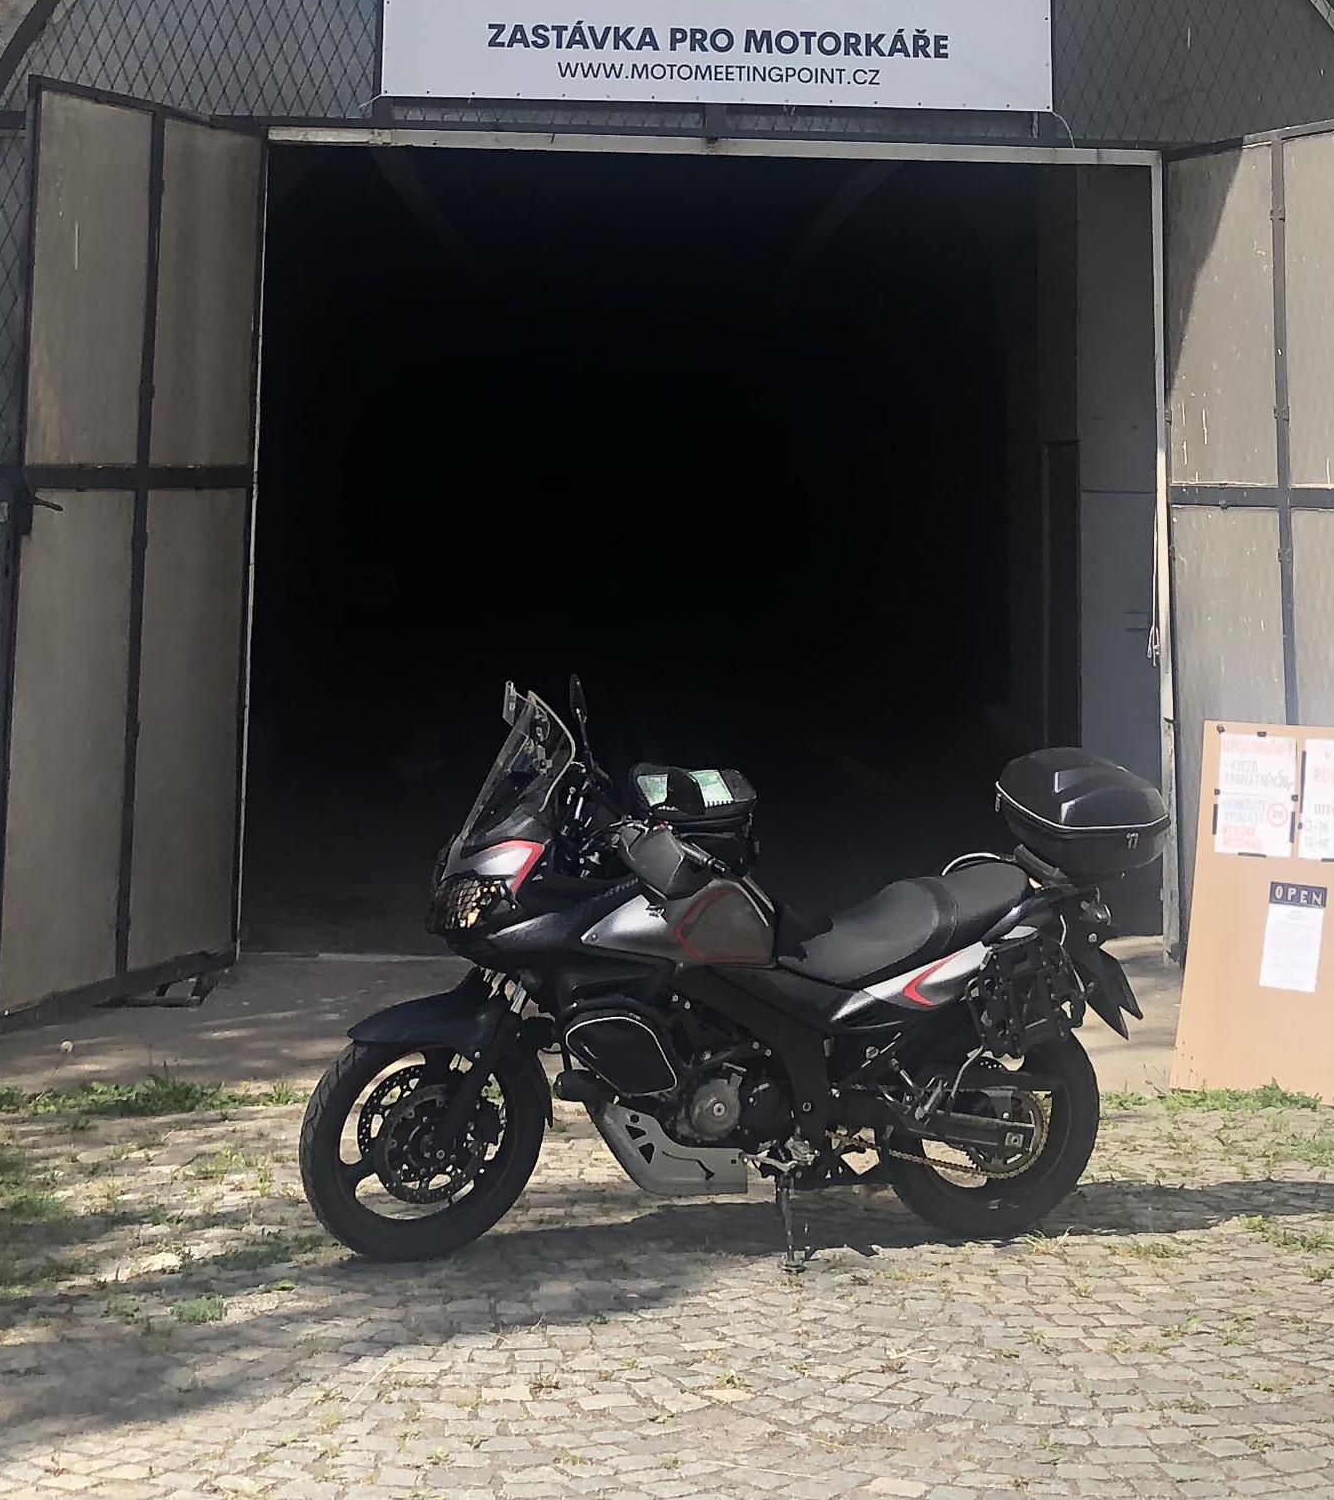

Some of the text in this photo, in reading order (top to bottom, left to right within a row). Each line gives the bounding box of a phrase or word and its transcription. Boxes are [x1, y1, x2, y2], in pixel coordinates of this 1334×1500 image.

[487, 20, 949, 59] ZASTÁVKA PRO MOTORKÁŘE
[557, 61, 881, 86] WWW.MOTOMEETINGPOINT.CZ
[1274, 885, 1323, 906] OPEN
